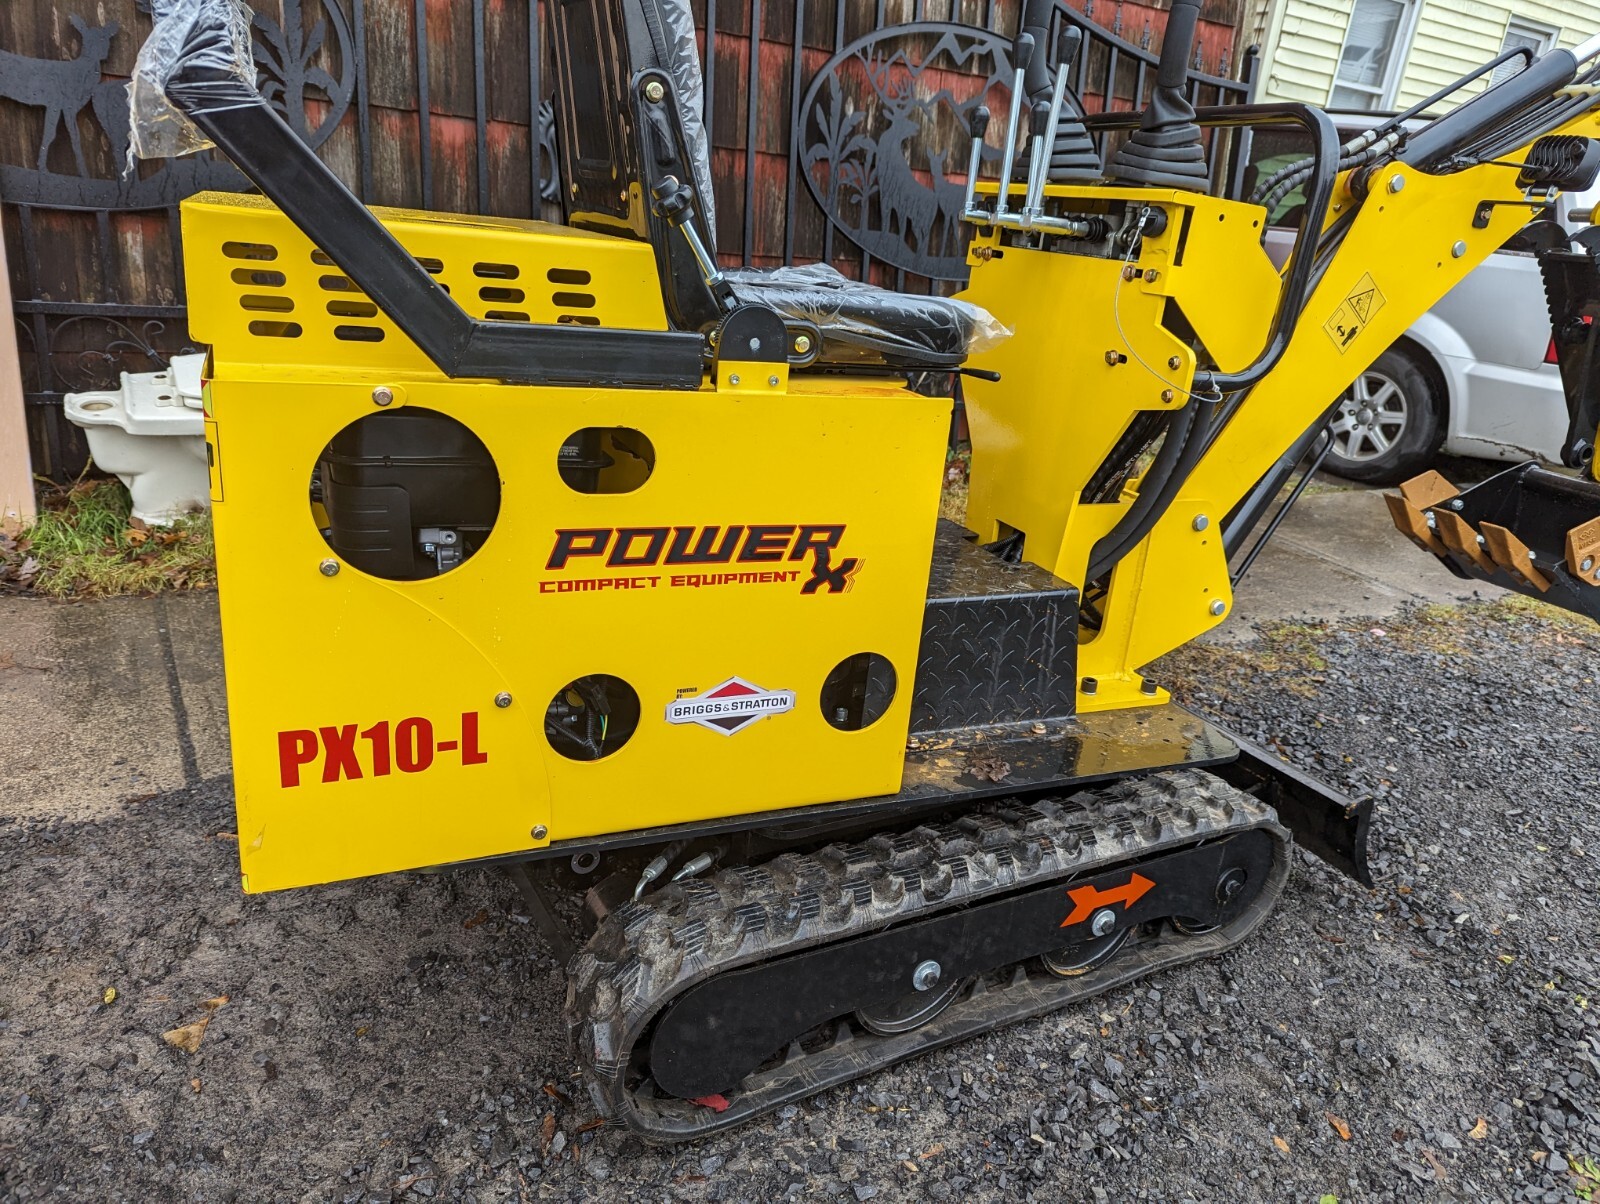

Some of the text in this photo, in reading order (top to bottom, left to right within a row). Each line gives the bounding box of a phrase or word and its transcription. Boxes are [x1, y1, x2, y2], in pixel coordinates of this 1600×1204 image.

[538, 570, 801, 594] COMPACT EQUIPMENT
[277, 711, 488, 788] PX10-L
